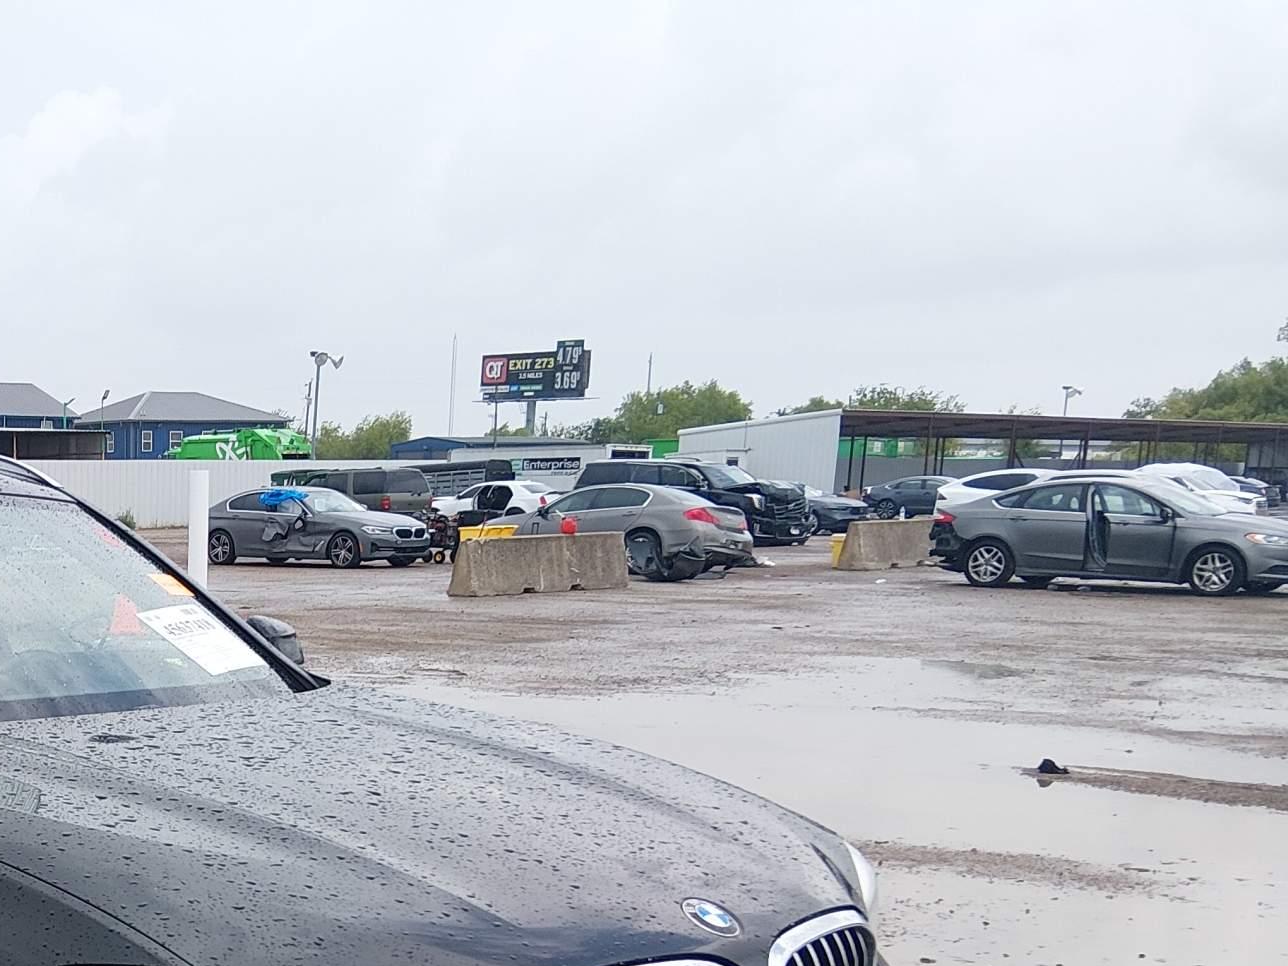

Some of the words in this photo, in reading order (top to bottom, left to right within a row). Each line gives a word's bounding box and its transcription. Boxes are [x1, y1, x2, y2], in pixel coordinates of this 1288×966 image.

[485, 361, 504, 380] QT
[509, 359, 532, 371] EXIT
[534, 357, 555, 369] 273
[523, 459, 580, 471] Enterprise
